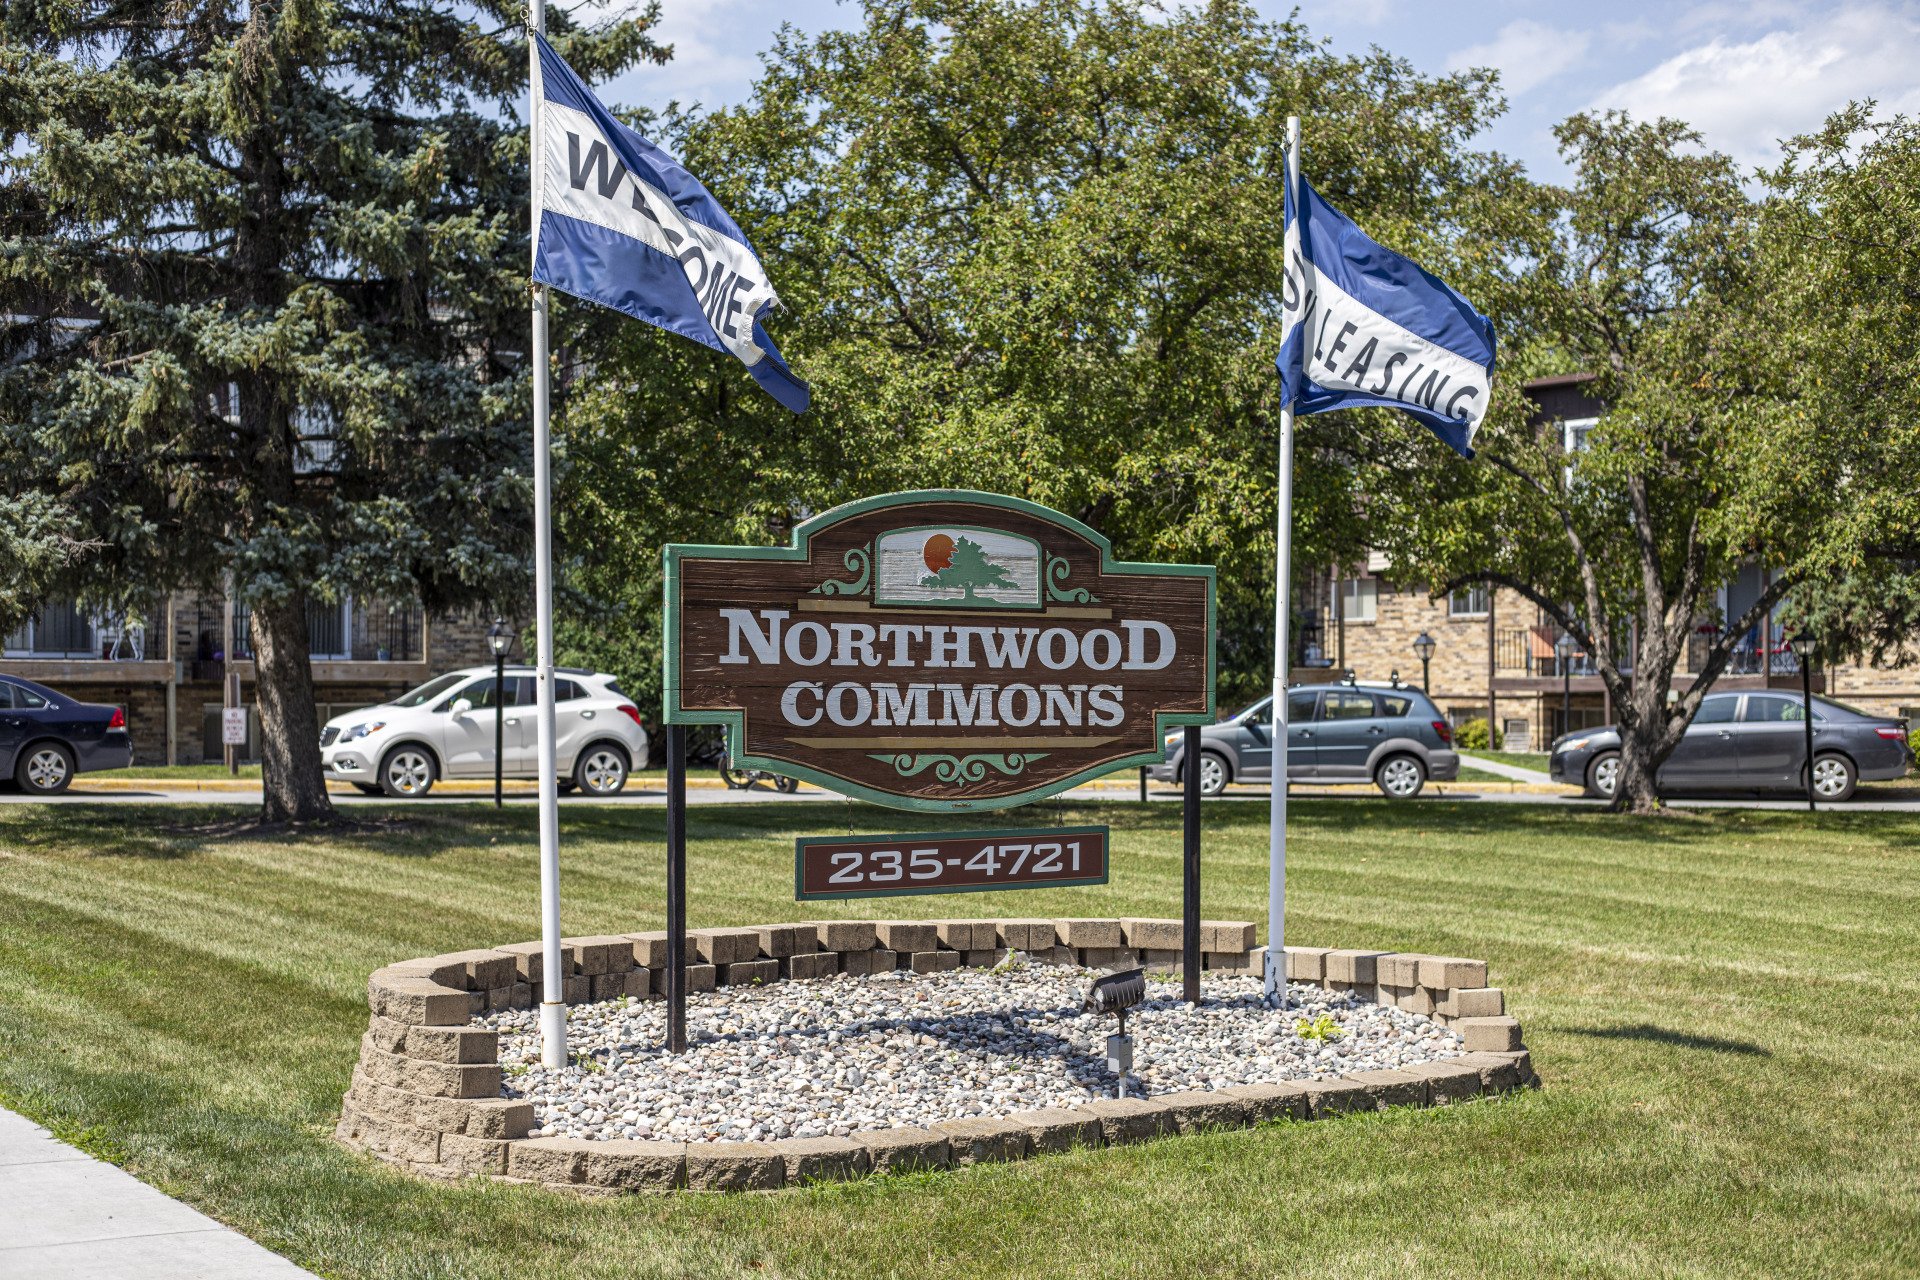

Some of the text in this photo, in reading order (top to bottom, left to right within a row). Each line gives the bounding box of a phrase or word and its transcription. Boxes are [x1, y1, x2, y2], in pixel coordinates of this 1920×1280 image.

[566, 130, 756, 339] WOME
[1313, 308, 1480, 421] LEASING
[718, 608, 1177, 671] NORTHWOOD
[780, 681, 1125, 727] COMMONS
[828, 841, 1080, 884] 235-4721
